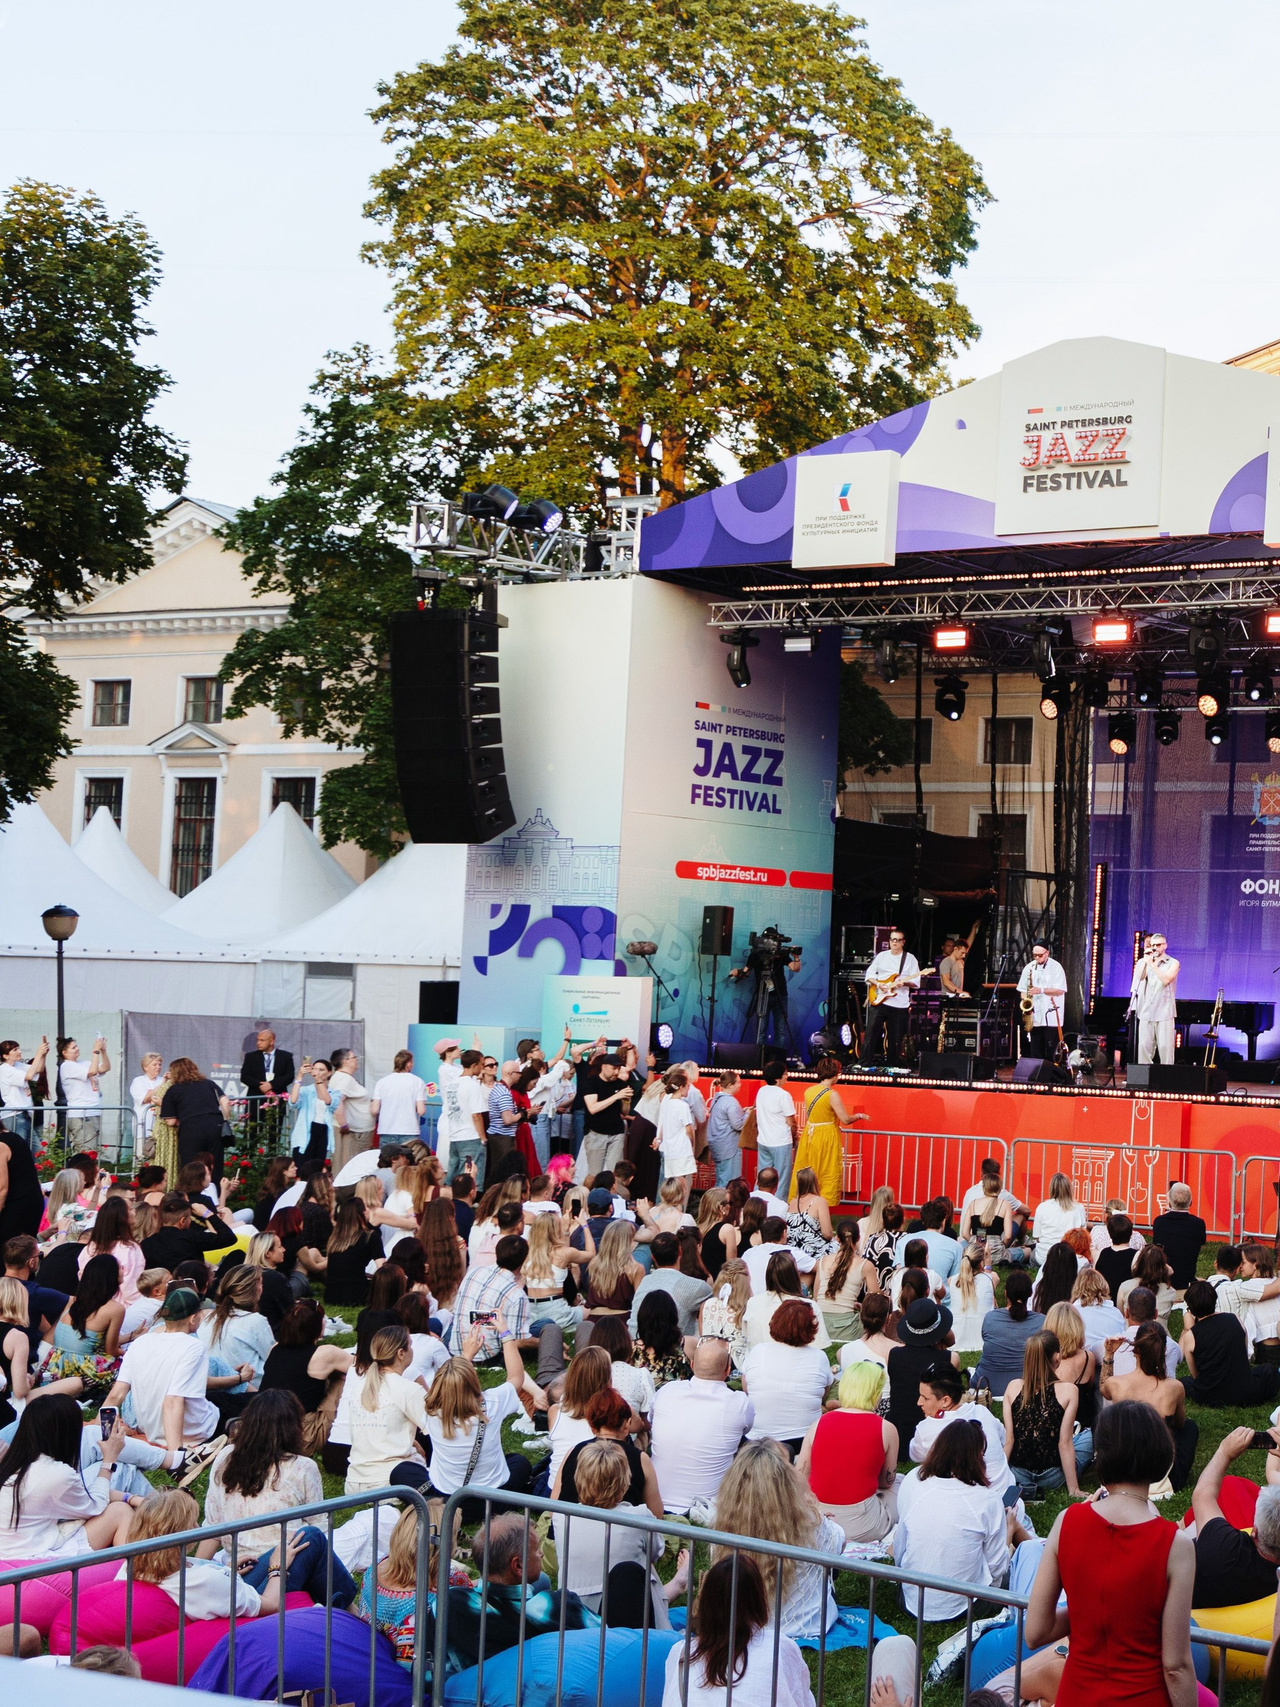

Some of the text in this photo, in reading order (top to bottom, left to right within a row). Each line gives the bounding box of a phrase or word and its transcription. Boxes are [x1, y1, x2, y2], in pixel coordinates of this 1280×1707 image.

[1069, 399, 1135, 411] МЕЖДУНАРОДНЫЙ
[1025, 414, 1133, 432] SAINT PETERSBURG
[1019, 428, 1130, 468] JAZZ
[1022, 468, 1129, 493] FESTIVAL
[802, 521, 855, 529] ПРЕЗИДЕНТСКОГО
[828, 513, 866, 521] ПОДДЕРЖКЕ
[694, 719, 786, 744] SAINT PETERSBURG
[692, 737, 784, 787] JAZZ
[690, 783, 782, 815] FESTIVAL
[697, 865, 768, 883] spbjazzfest.ru
[1239, 899, 1260, 907] ИГОРЯ
